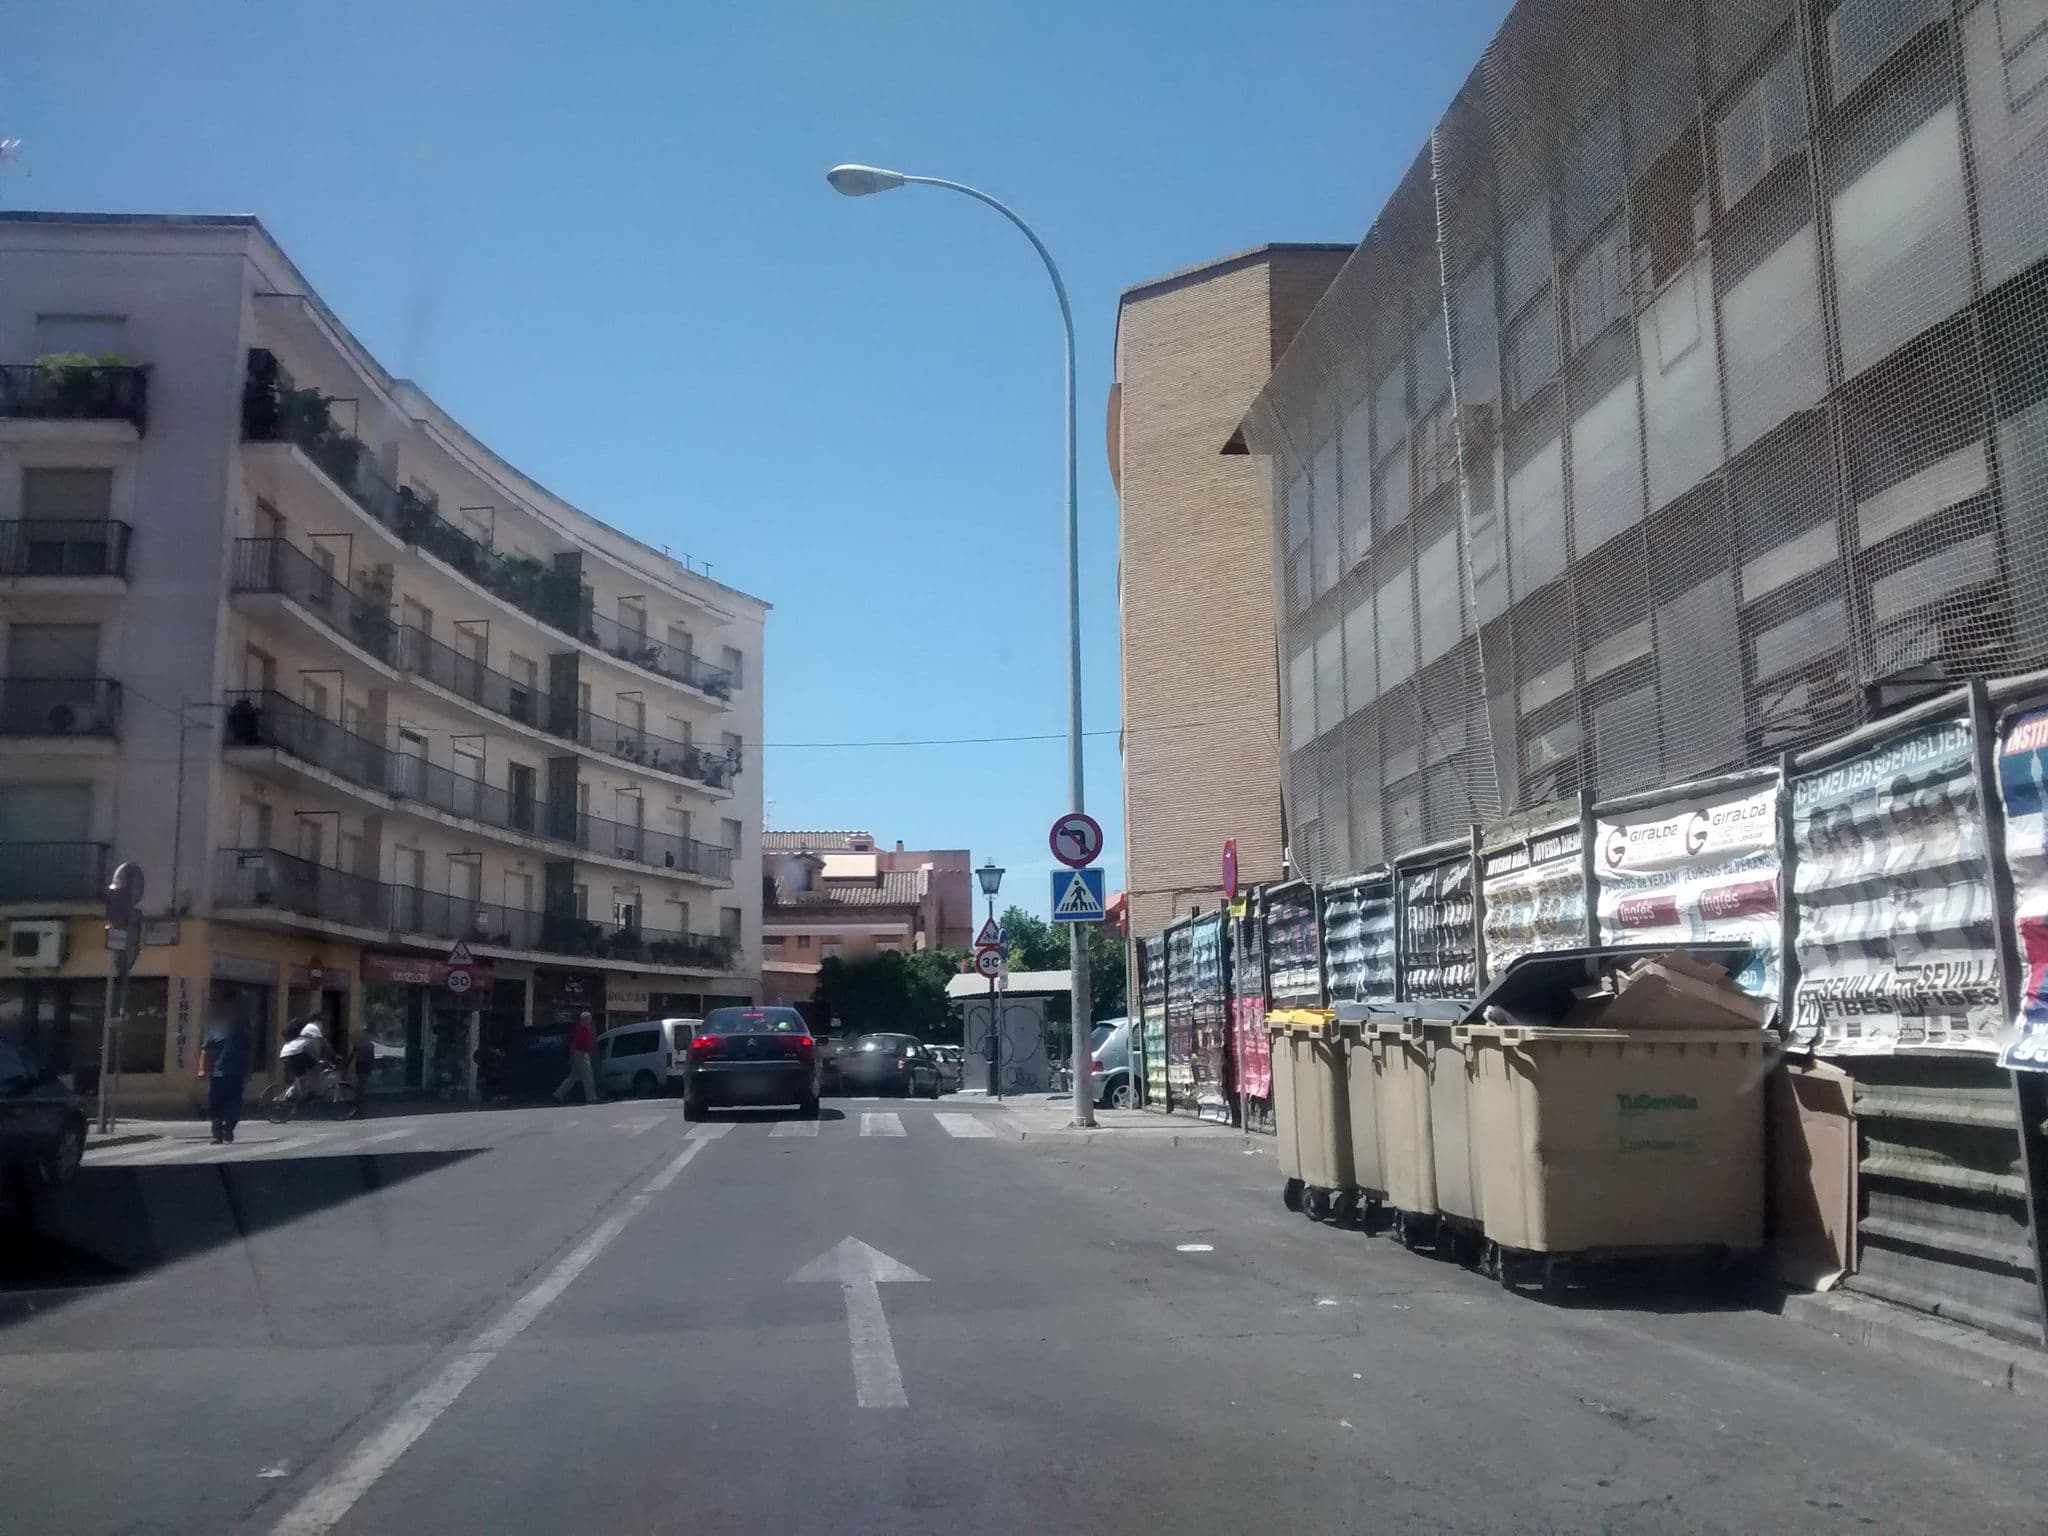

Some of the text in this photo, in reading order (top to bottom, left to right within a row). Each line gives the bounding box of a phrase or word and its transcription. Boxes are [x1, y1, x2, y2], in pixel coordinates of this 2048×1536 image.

[1880, 727, 1973, 774] GEMELIER
[1795, 757, 1884, 806] GEMELIERS
[450, 975, 469, 987] 30
[1916, 987, 2000, 1007] FIBES
[1821, 998, 1894, 1018] FIBES
